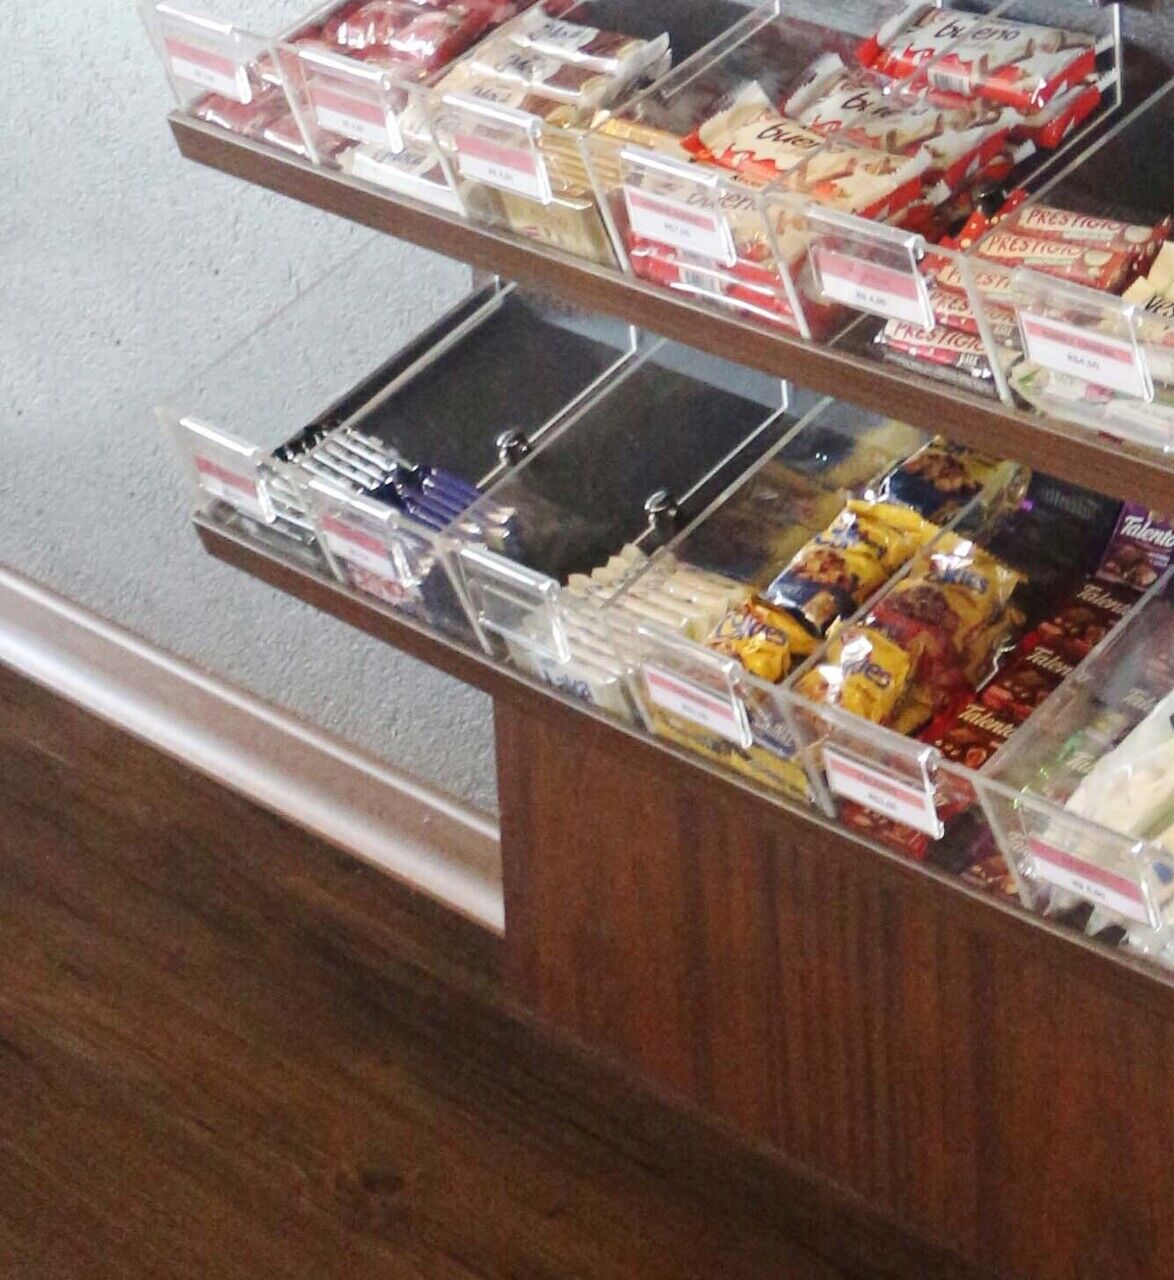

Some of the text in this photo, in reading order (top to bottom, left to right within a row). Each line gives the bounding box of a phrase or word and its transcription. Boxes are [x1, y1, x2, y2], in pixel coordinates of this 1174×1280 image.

[933, 20, 1021, 43] bueno
[1075, 583, 1131, 615] Talen
[1026, 646, 1076, 677] Talen
[958, 703, 1017, 739] Talent
